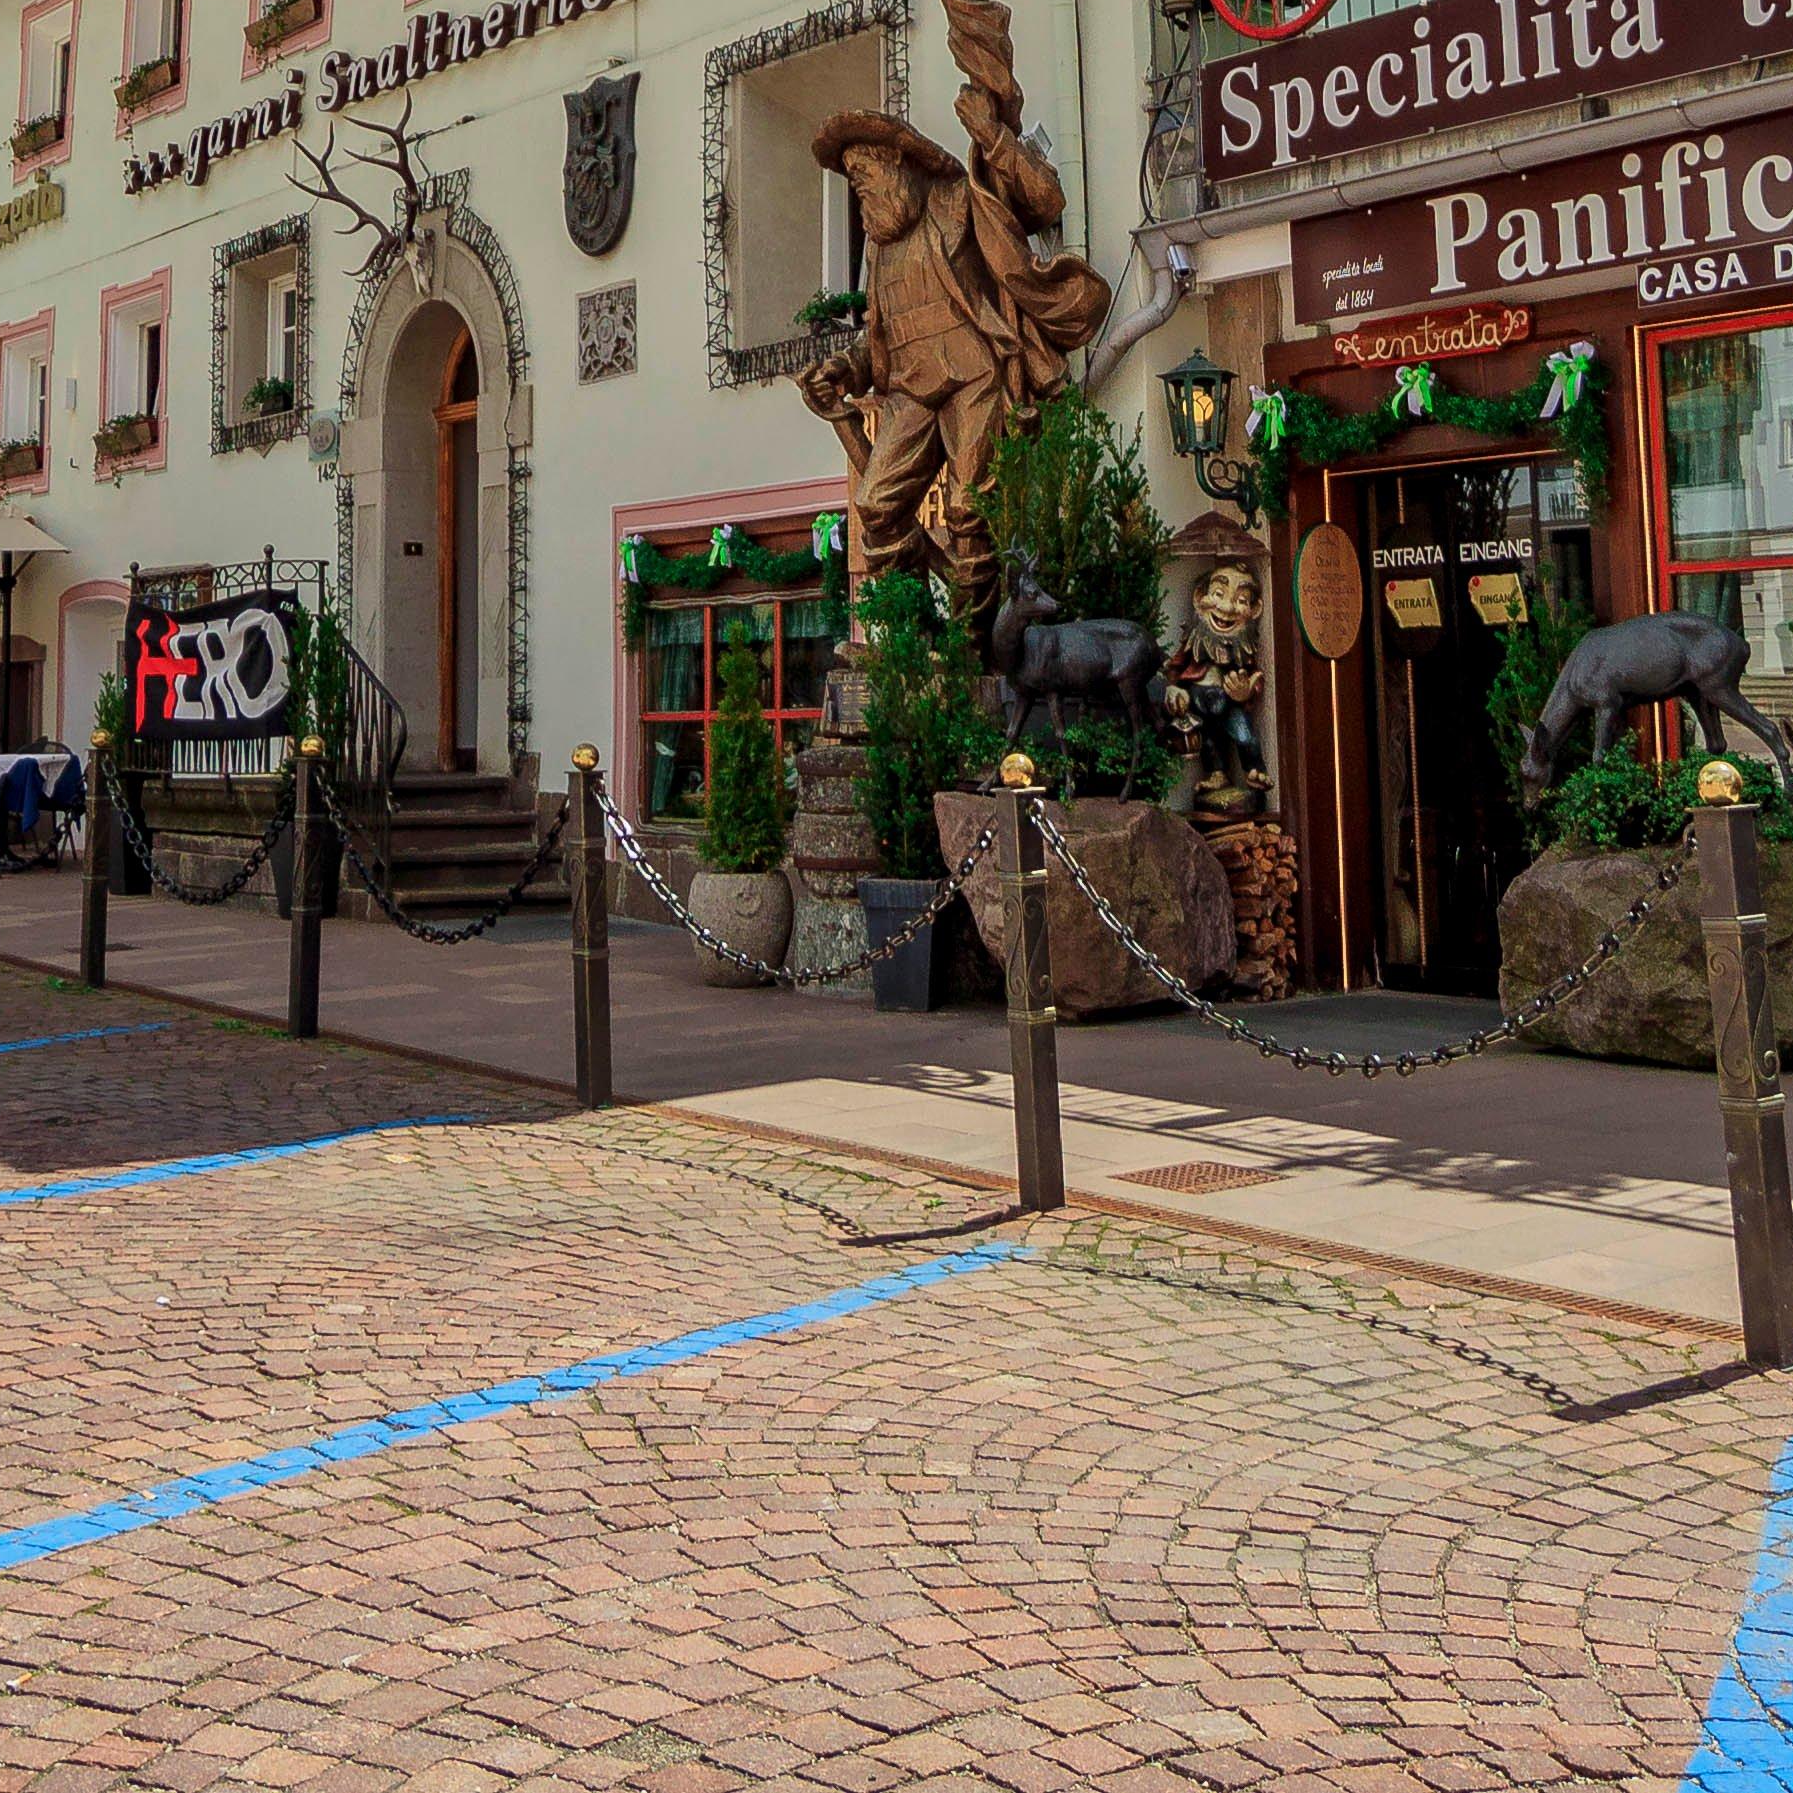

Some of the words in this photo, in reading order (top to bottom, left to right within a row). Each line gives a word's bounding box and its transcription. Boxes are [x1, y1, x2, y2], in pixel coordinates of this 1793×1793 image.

[184, 69, 304, 186] garni
[1351, 289, 1375, 309] 1864
[1638, 252, 1749, 303] CASA
[1368, 308, 1502, 361] entrata
[1373, 545, 1445, 568] ENTRATA
[1459, 538, 1532, 562] EINGANG
[1394, 597, 1433, 609] ENTRATA
[135, 608, 290, 734] HERO
